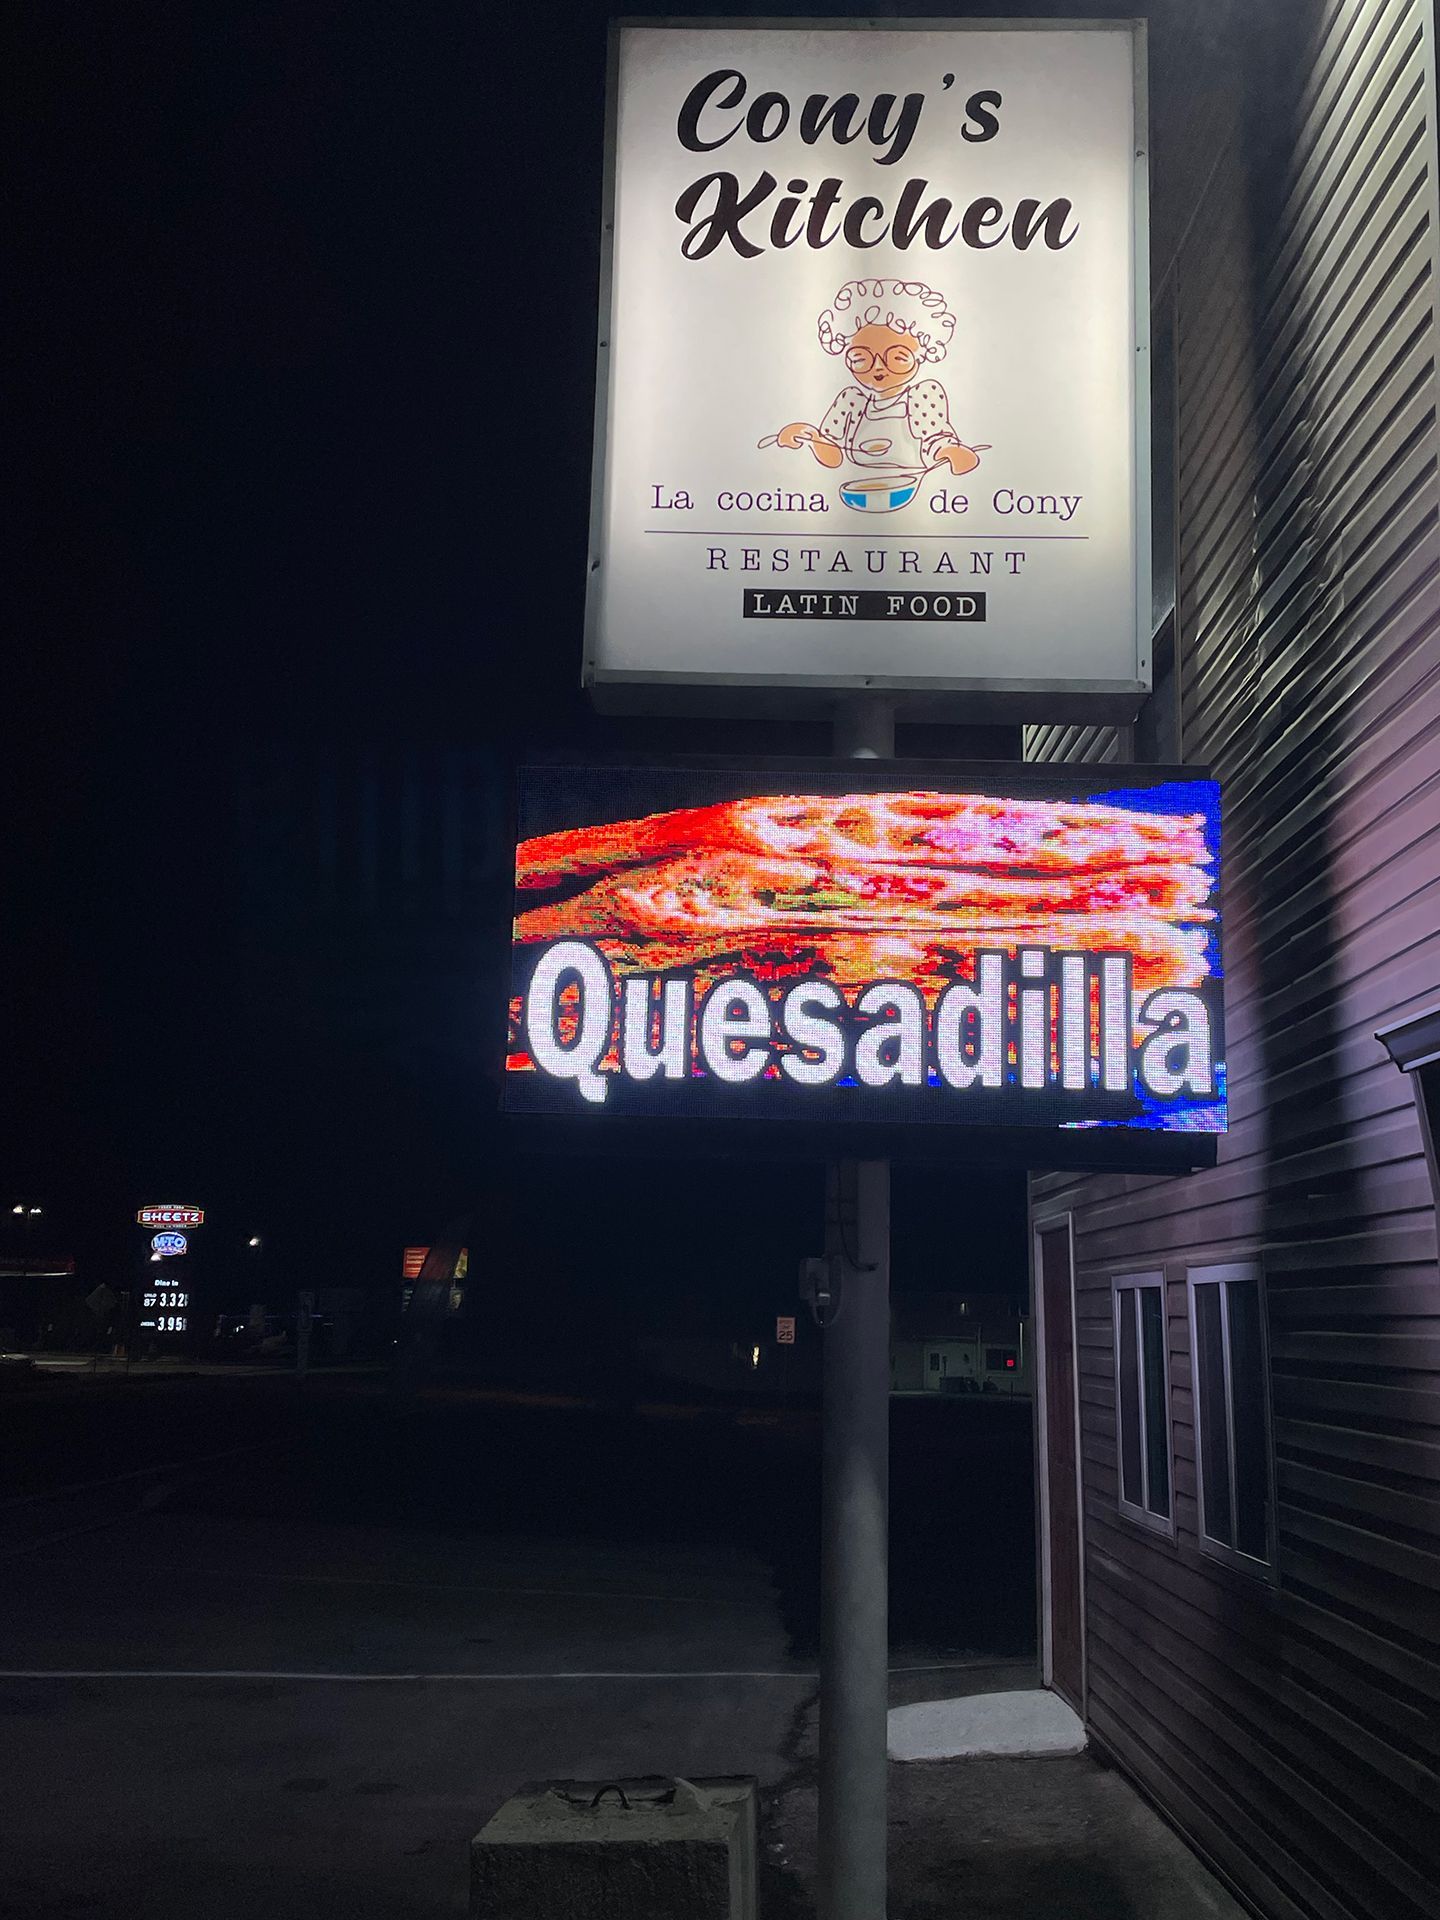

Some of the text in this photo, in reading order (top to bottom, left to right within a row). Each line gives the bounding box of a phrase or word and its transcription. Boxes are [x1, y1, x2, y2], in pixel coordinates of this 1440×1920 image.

[677, 69, 1002, 165] Cony's
[674, 171, 1080, 260] Kitchen
[651, 484, 1082, 520] La cocina de Cony
[706, 547, 1028, 575] RESTAURANT
[752, 594, 978, 617] LATIN FOOD
[526, 940, 1212, 1102] Quesadilla
[142, 1212, 199, 1222] SHEETZ
[143, 1299, 156, 1307] 87
[159, 1292, 185, 1307] 3.32
[157, 1316, 183, 1331] 3.95
[779, 1330, 793, 1341] 25
